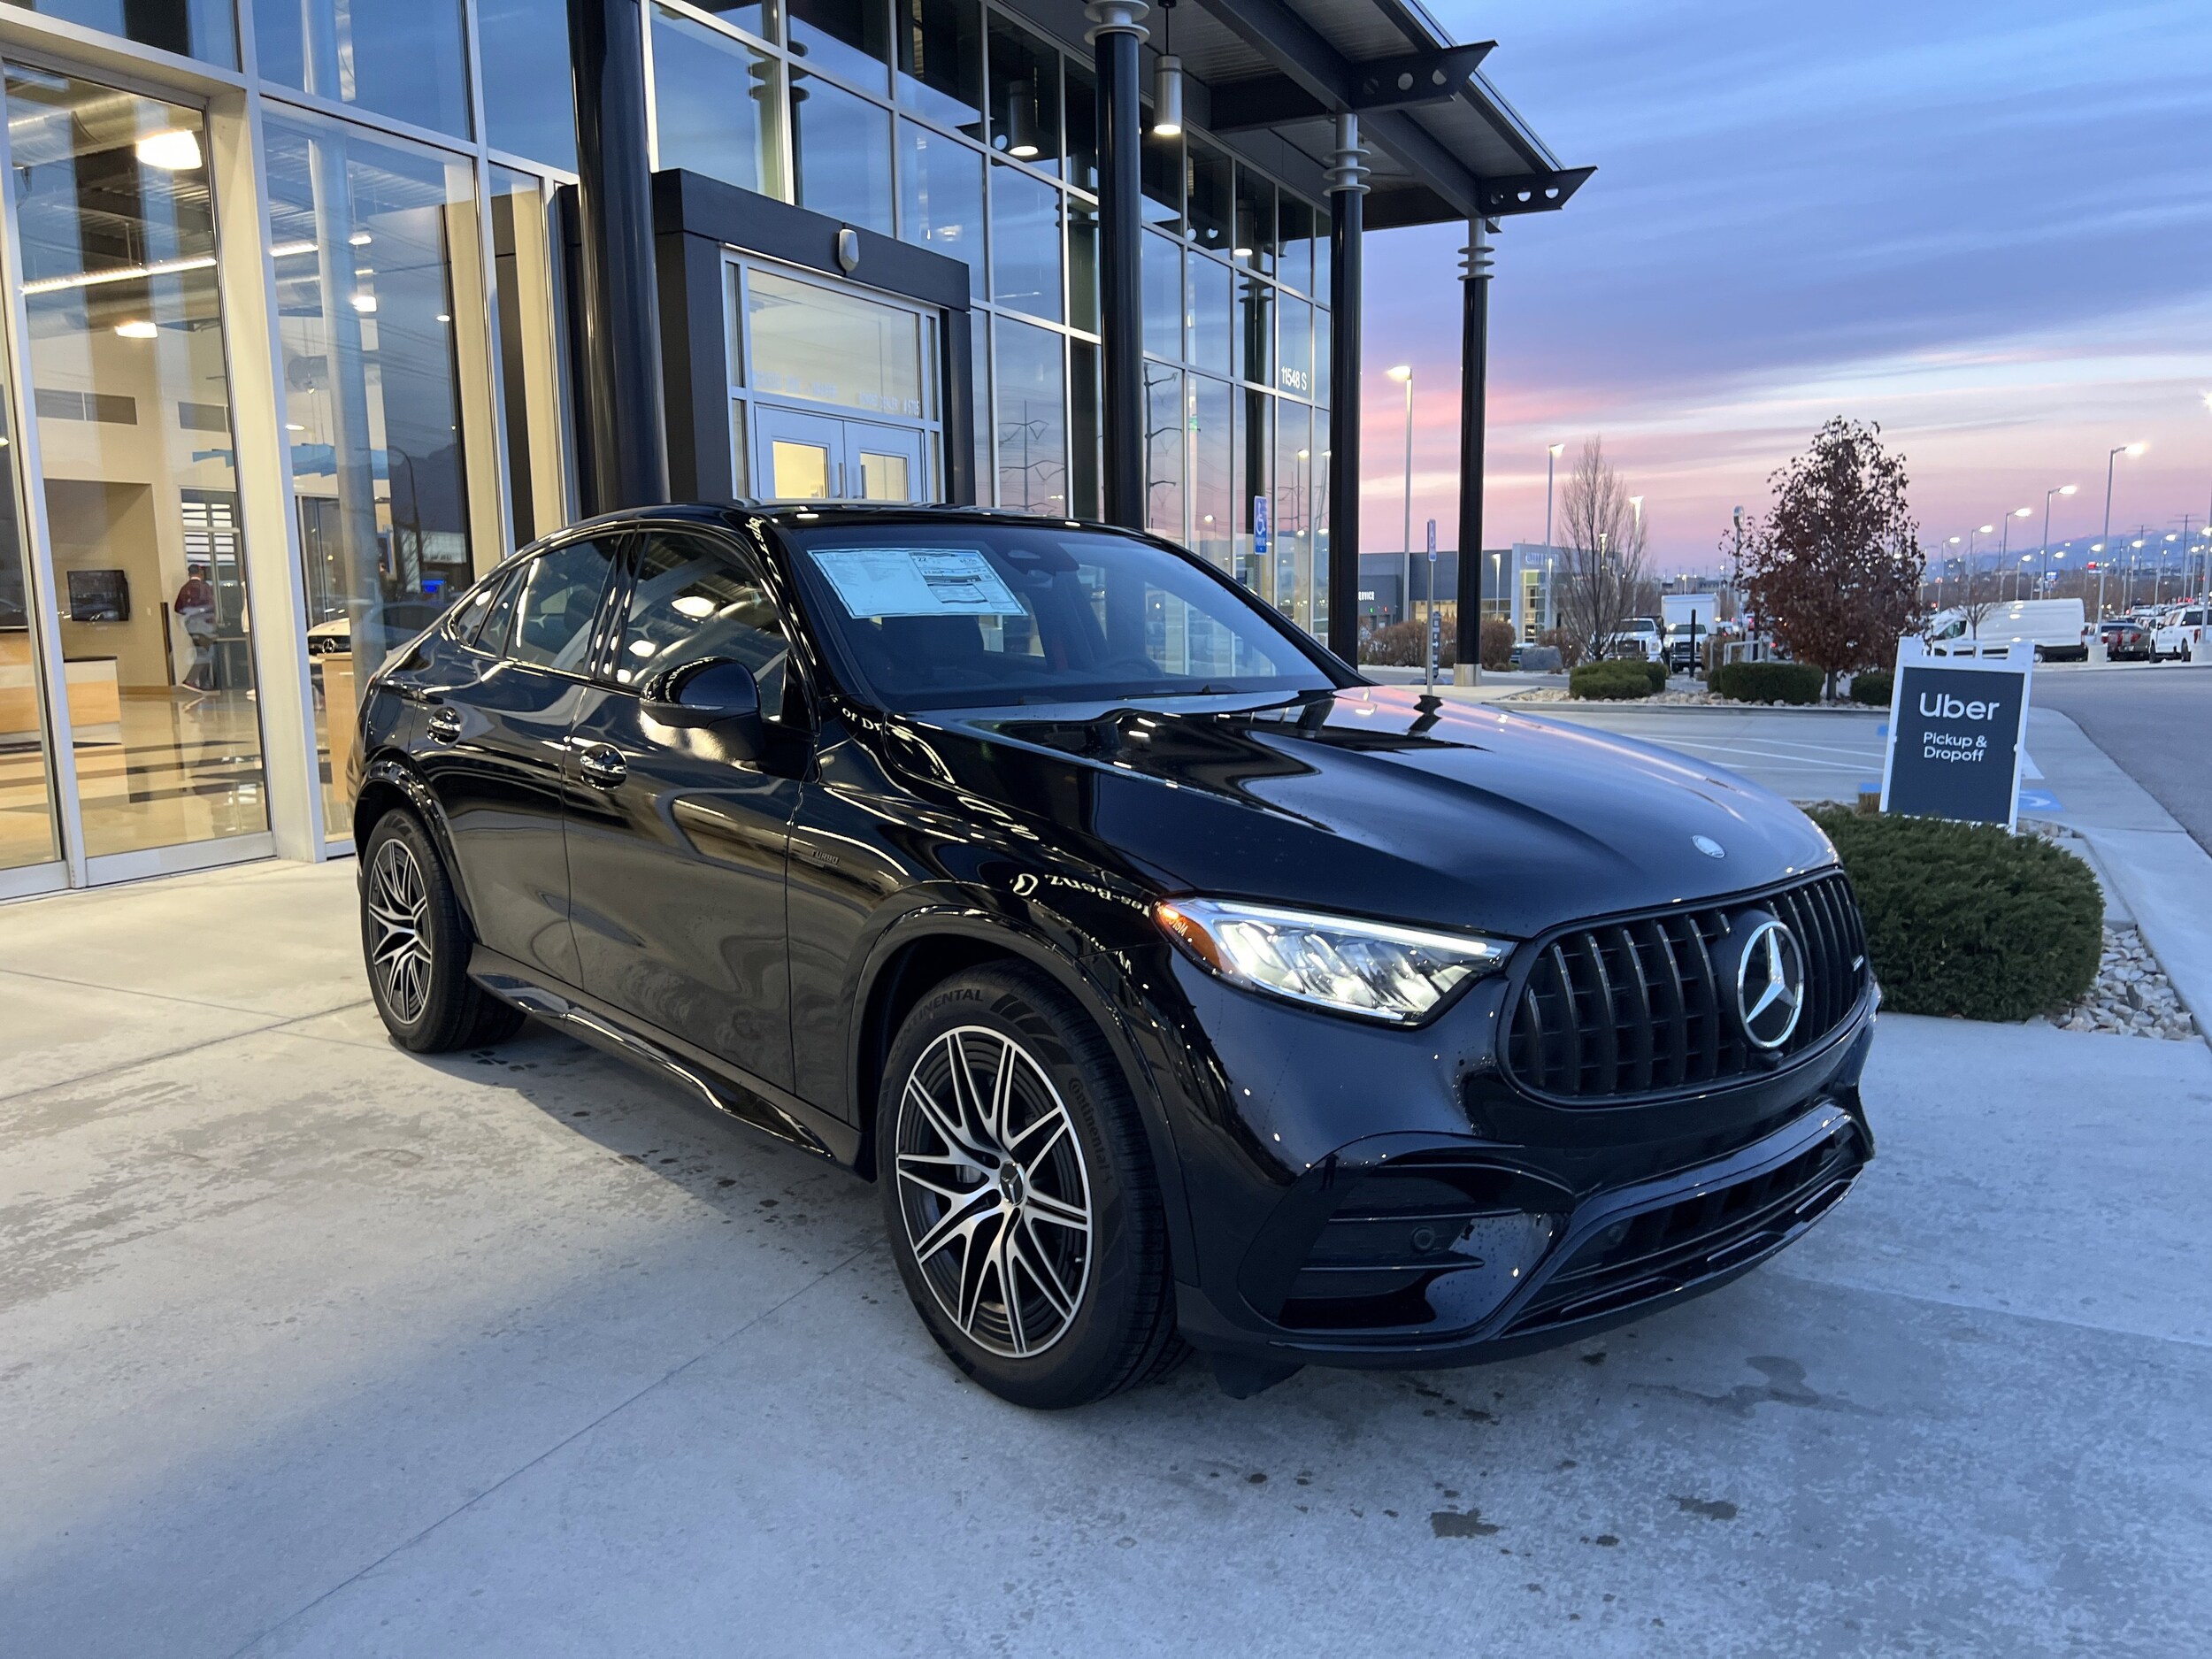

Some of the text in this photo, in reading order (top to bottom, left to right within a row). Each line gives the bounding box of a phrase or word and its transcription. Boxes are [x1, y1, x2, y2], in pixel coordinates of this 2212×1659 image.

[1281, 365, 1307, 391] 11548 S
[1358, 591, 1375, 601] ERVICE
[1919, 692, 2001, 720] Uber
[1923, 731, 1987, 749] Pickup &
[1924, 745, 1985, 763] Dropoff
[1068, 1077, 1110, 1170] Continental
